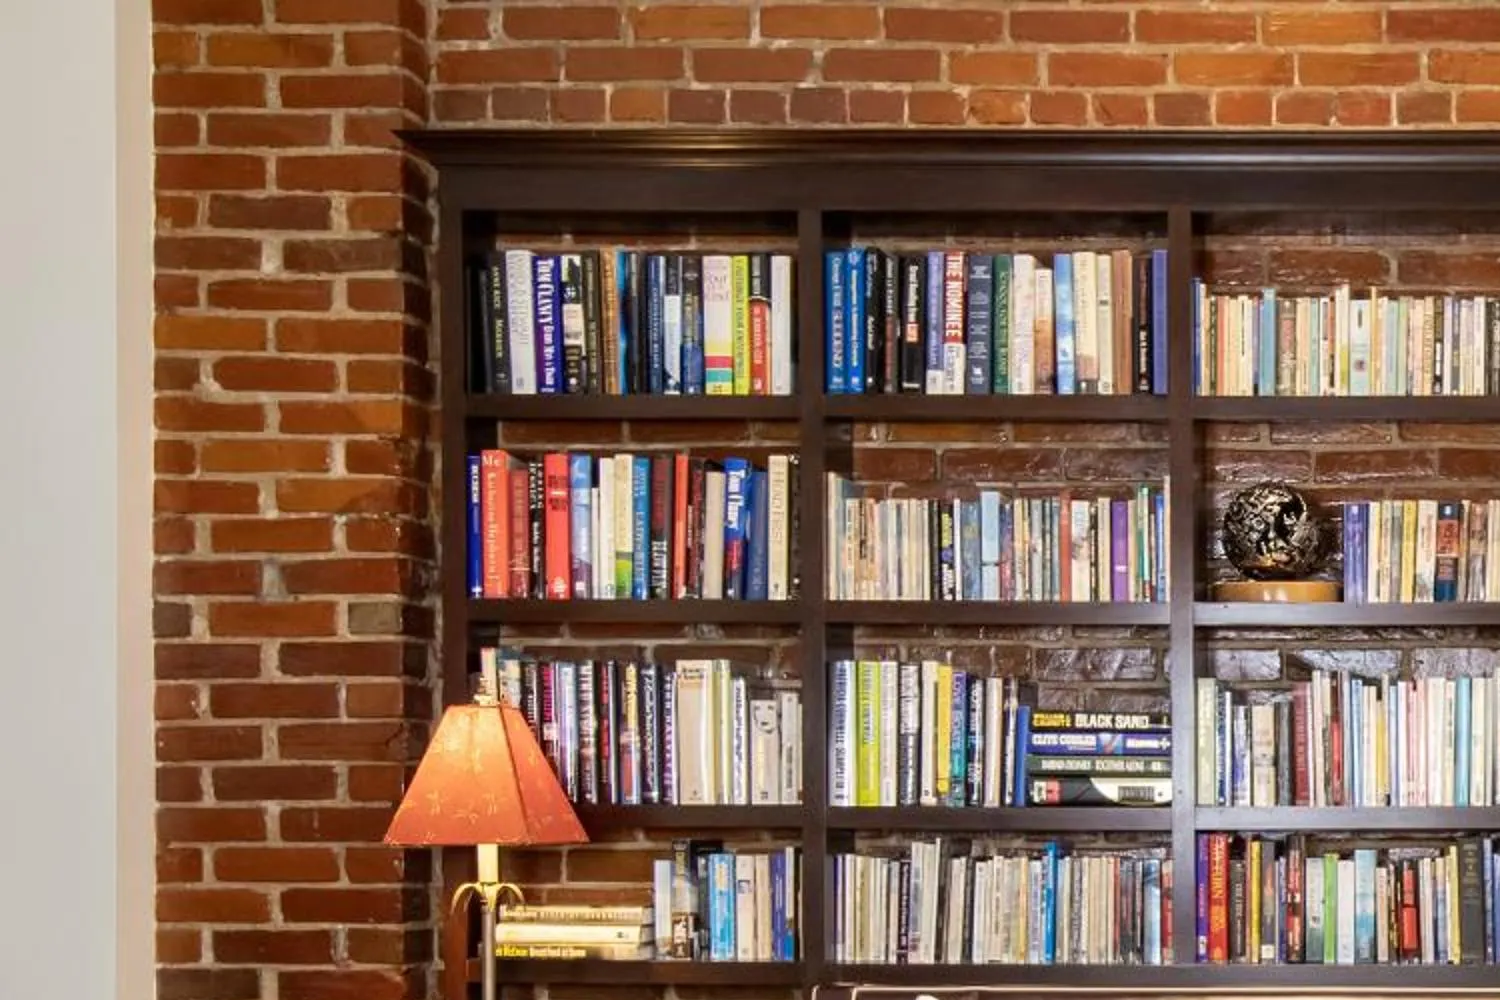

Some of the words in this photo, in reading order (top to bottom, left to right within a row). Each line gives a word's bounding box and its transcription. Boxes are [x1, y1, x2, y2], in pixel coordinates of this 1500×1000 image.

[537, 258, 555, 282] TOM
[945, 256, 963, 279] THE
[537, 284, 555, 325] CLANCY
[945, 281, 963, 337] NOMINEE
[1074, 713, 1112, 729] BLACK
